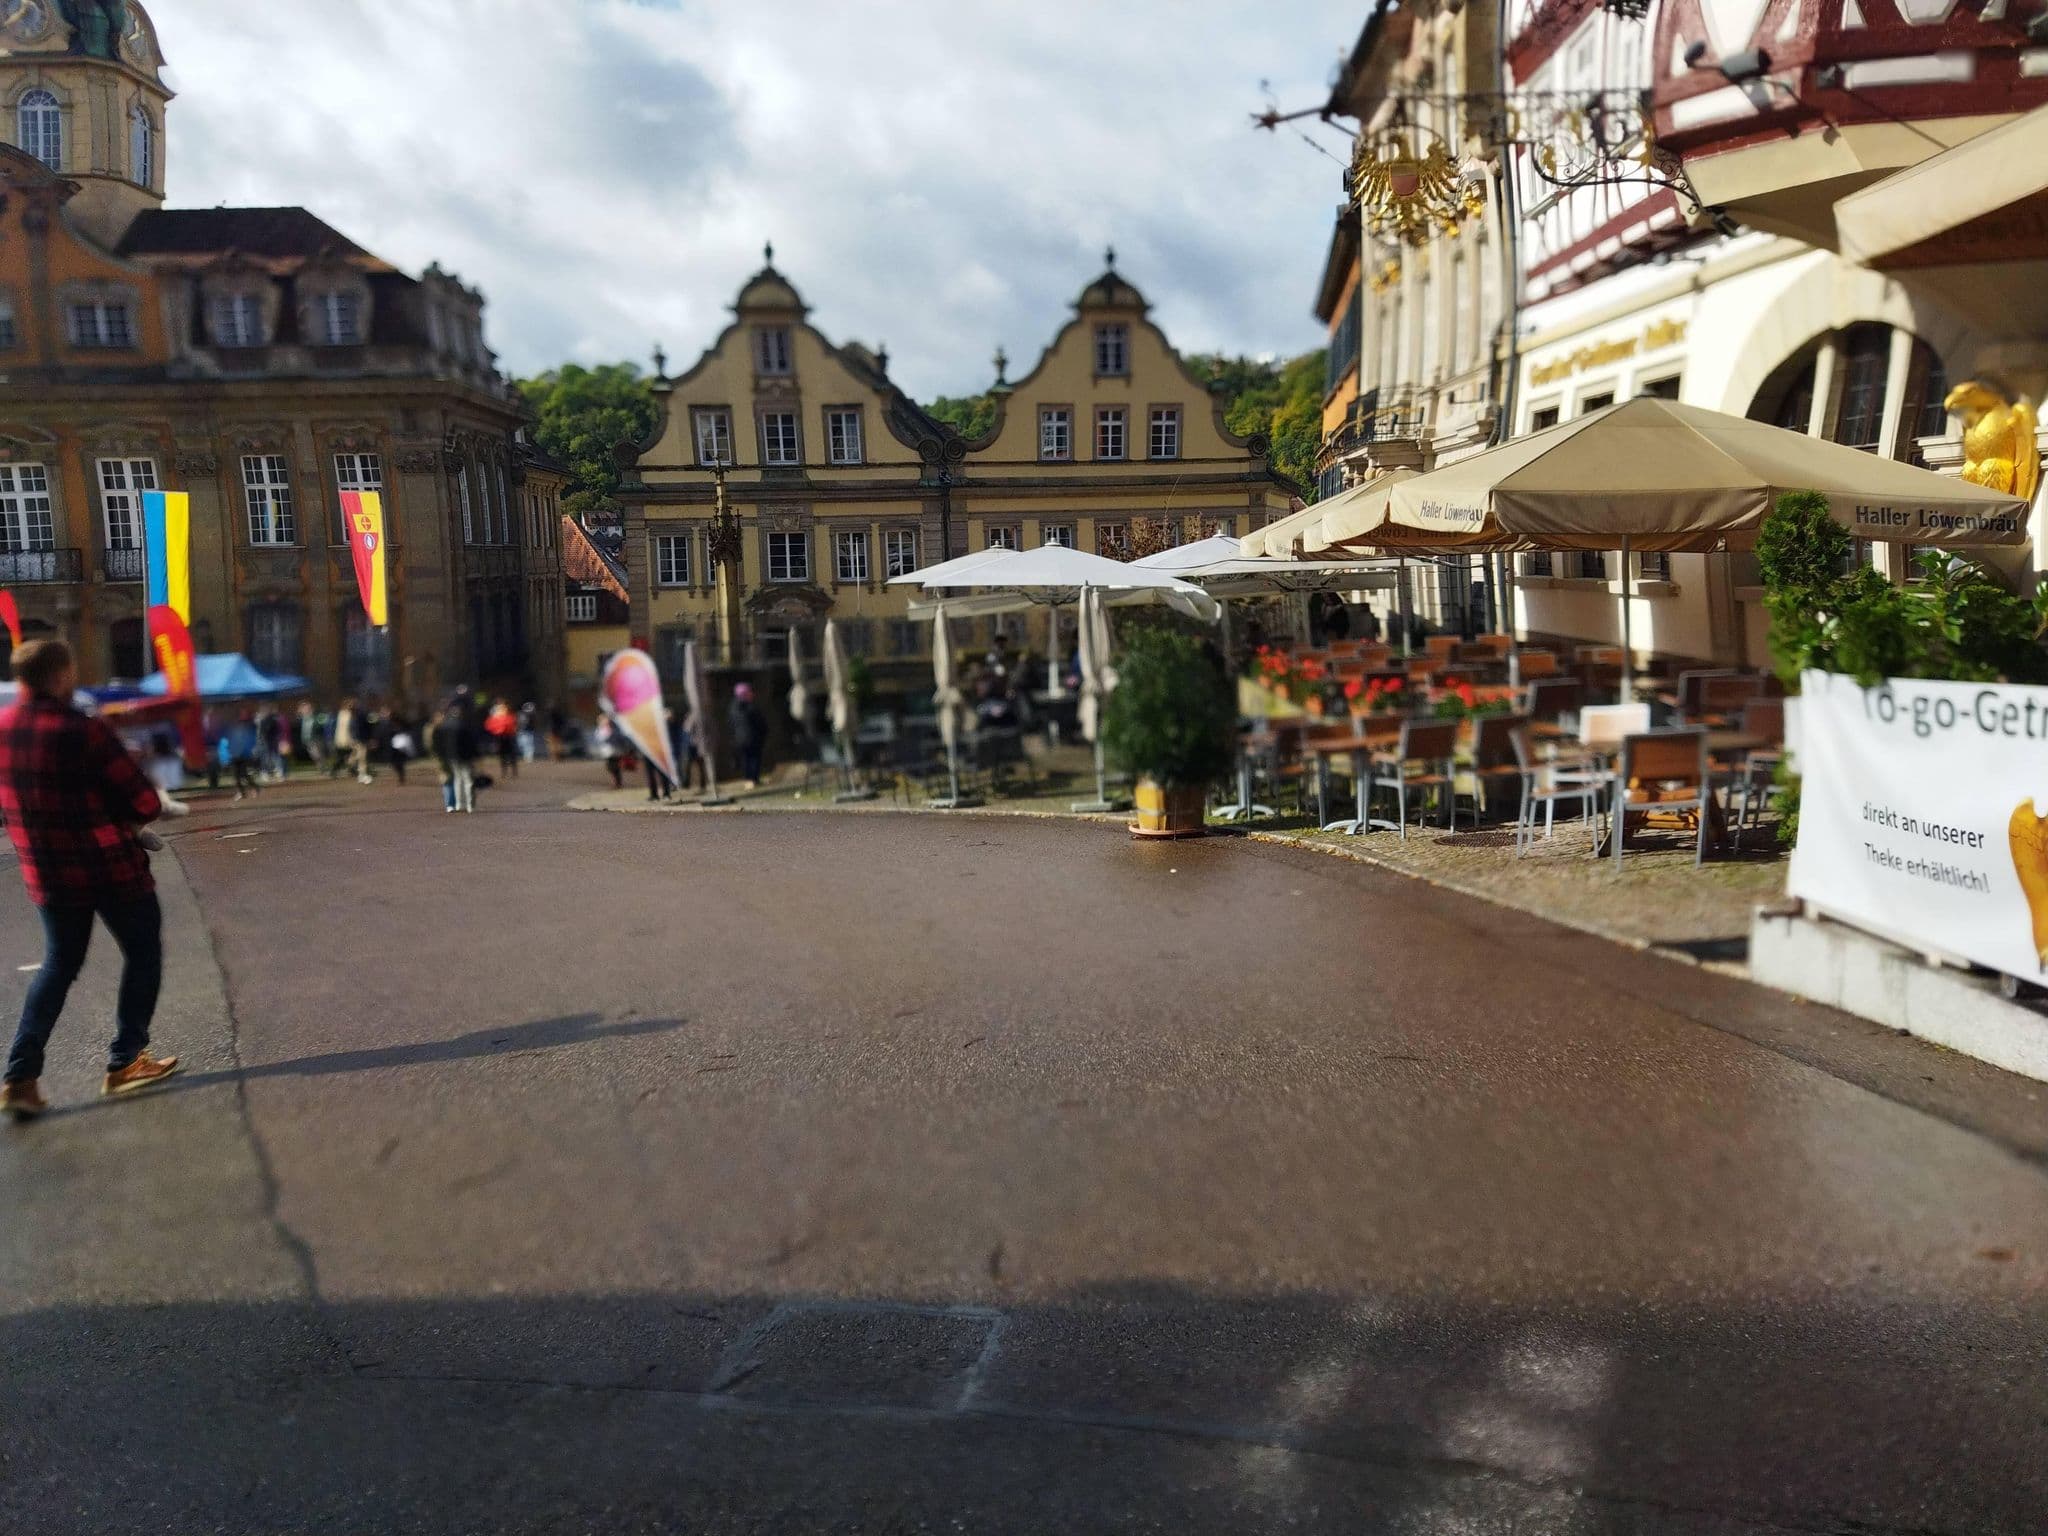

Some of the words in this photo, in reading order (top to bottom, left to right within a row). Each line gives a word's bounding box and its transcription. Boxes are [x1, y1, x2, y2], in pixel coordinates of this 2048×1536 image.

[1420, 500, 1441, 519] Haller
[1855, 505, 1911, 526] Haller
[1919, 509, 2018, 532] Löwenbräu
[1862, 801, 1898, 829] direkt
[1902, 816, 1919, 834] an
[1922, 821, 1984, 848] unserer
[1864, 842, 1903, 871] Theke
[1907, 857, 1990, 893] erhältlich!
